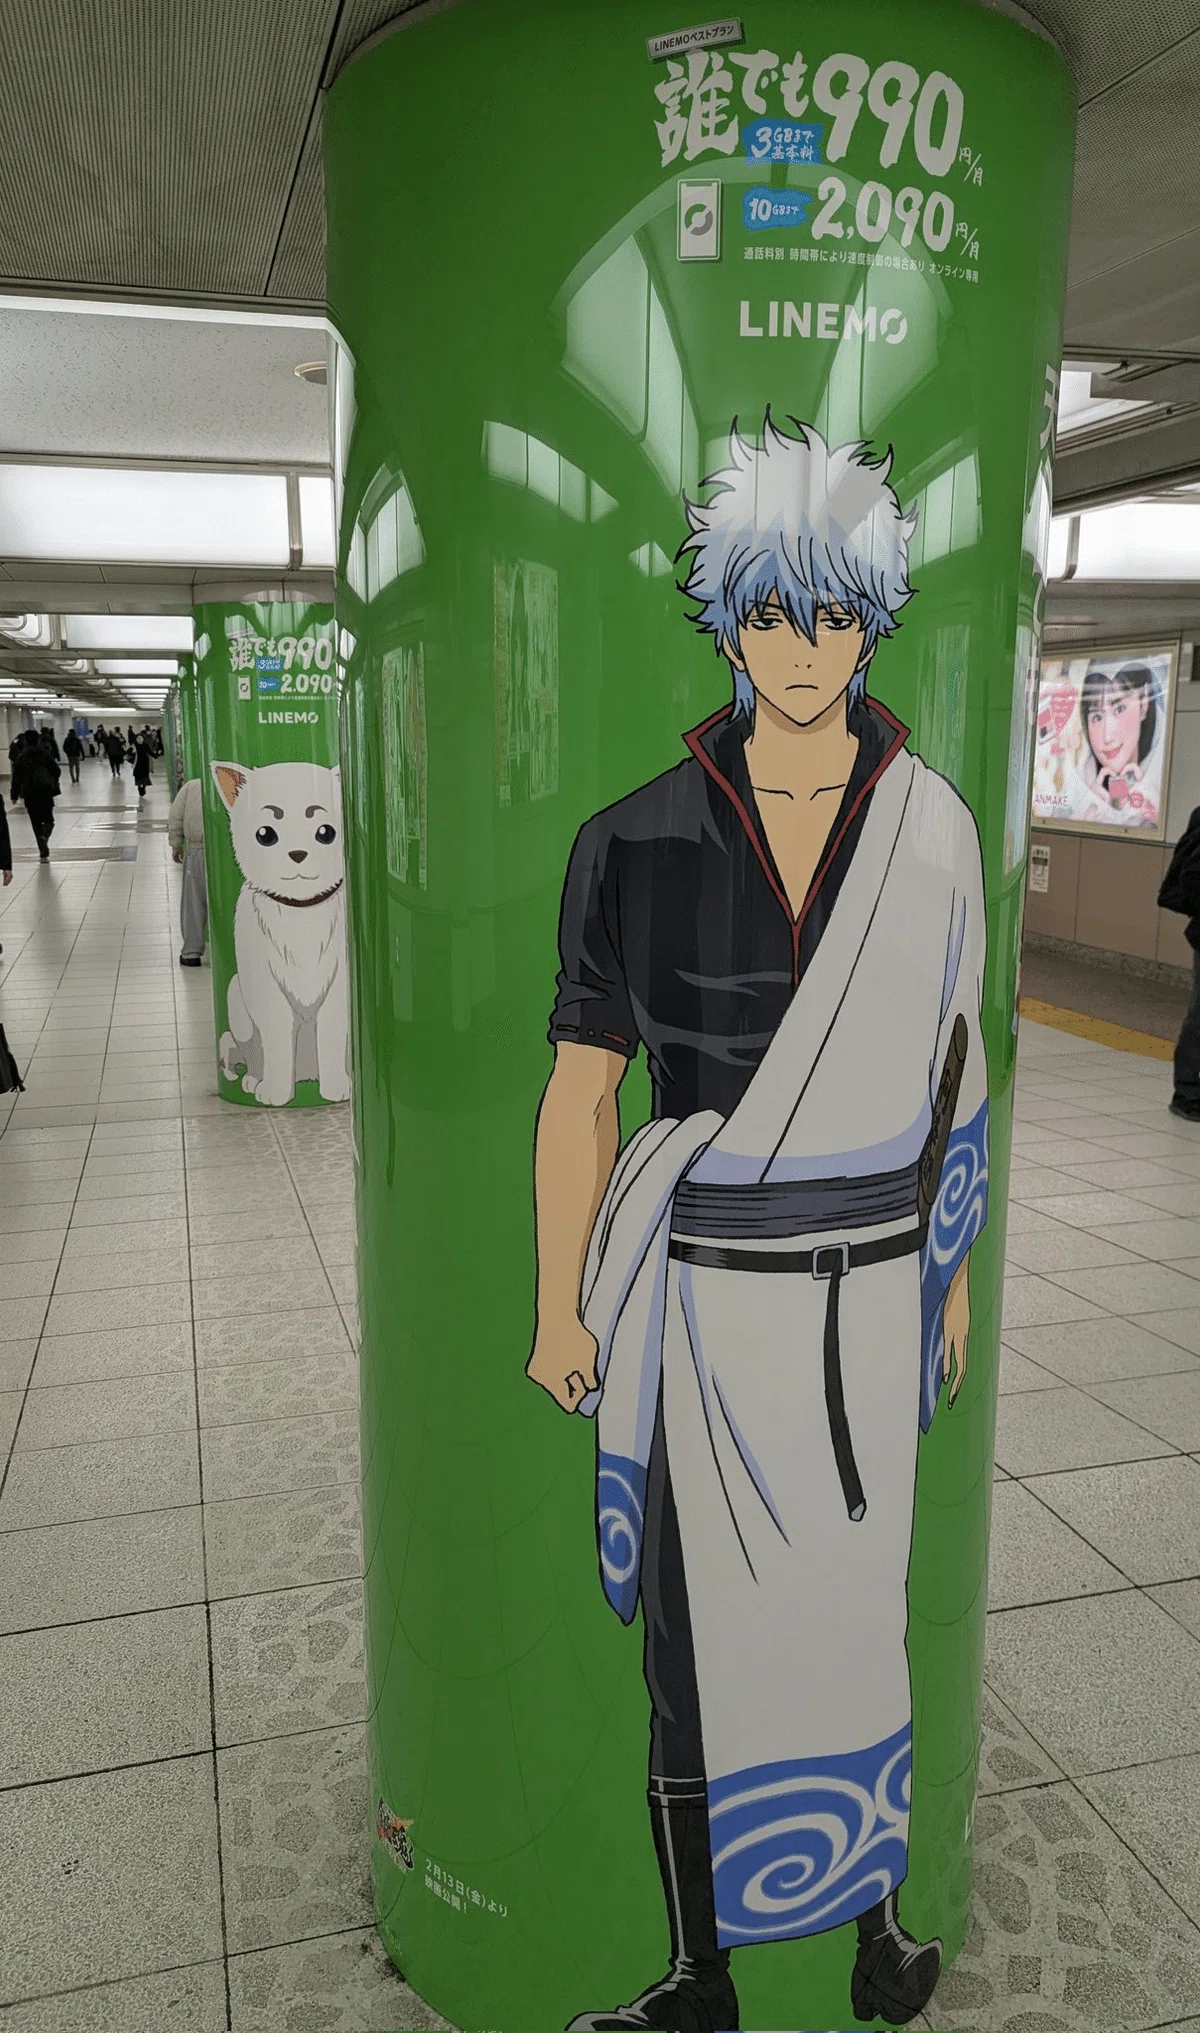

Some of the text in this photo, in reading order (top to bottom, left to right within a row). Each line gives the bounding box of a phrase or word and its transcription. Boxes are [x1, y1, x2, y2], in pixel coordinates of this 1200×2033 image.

[655, 25, 734, 51] LINEMOベストプラン
[744, 247, 785, 260] 通話料別
[739, 300, 907, 344] LINEMO
[258, 711, 319, 724] LINEMO
